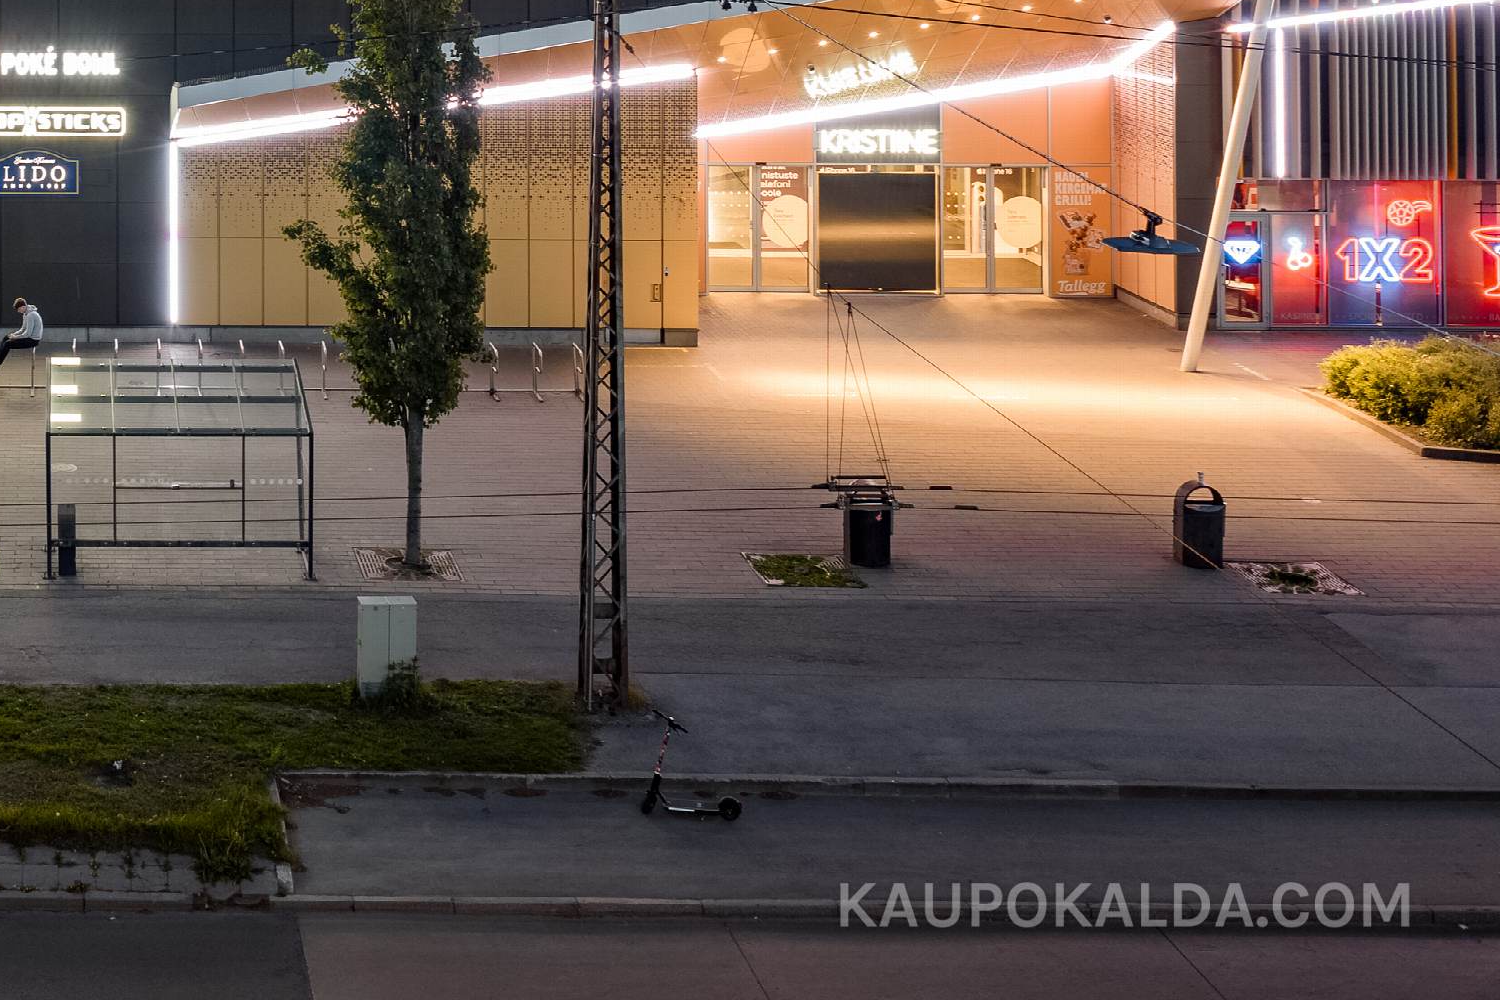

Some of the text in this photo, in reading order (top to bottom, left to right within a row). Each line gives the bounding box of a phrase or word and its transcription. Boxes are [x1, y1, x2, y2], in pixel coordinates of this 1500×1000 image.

[0, 45, 58, 76] POKÉ
[2, 165, 66, 182] LIDO
[1336, 237, 1433, 282] 1X2
[1057, 280, 1107, 294] Tallegg
